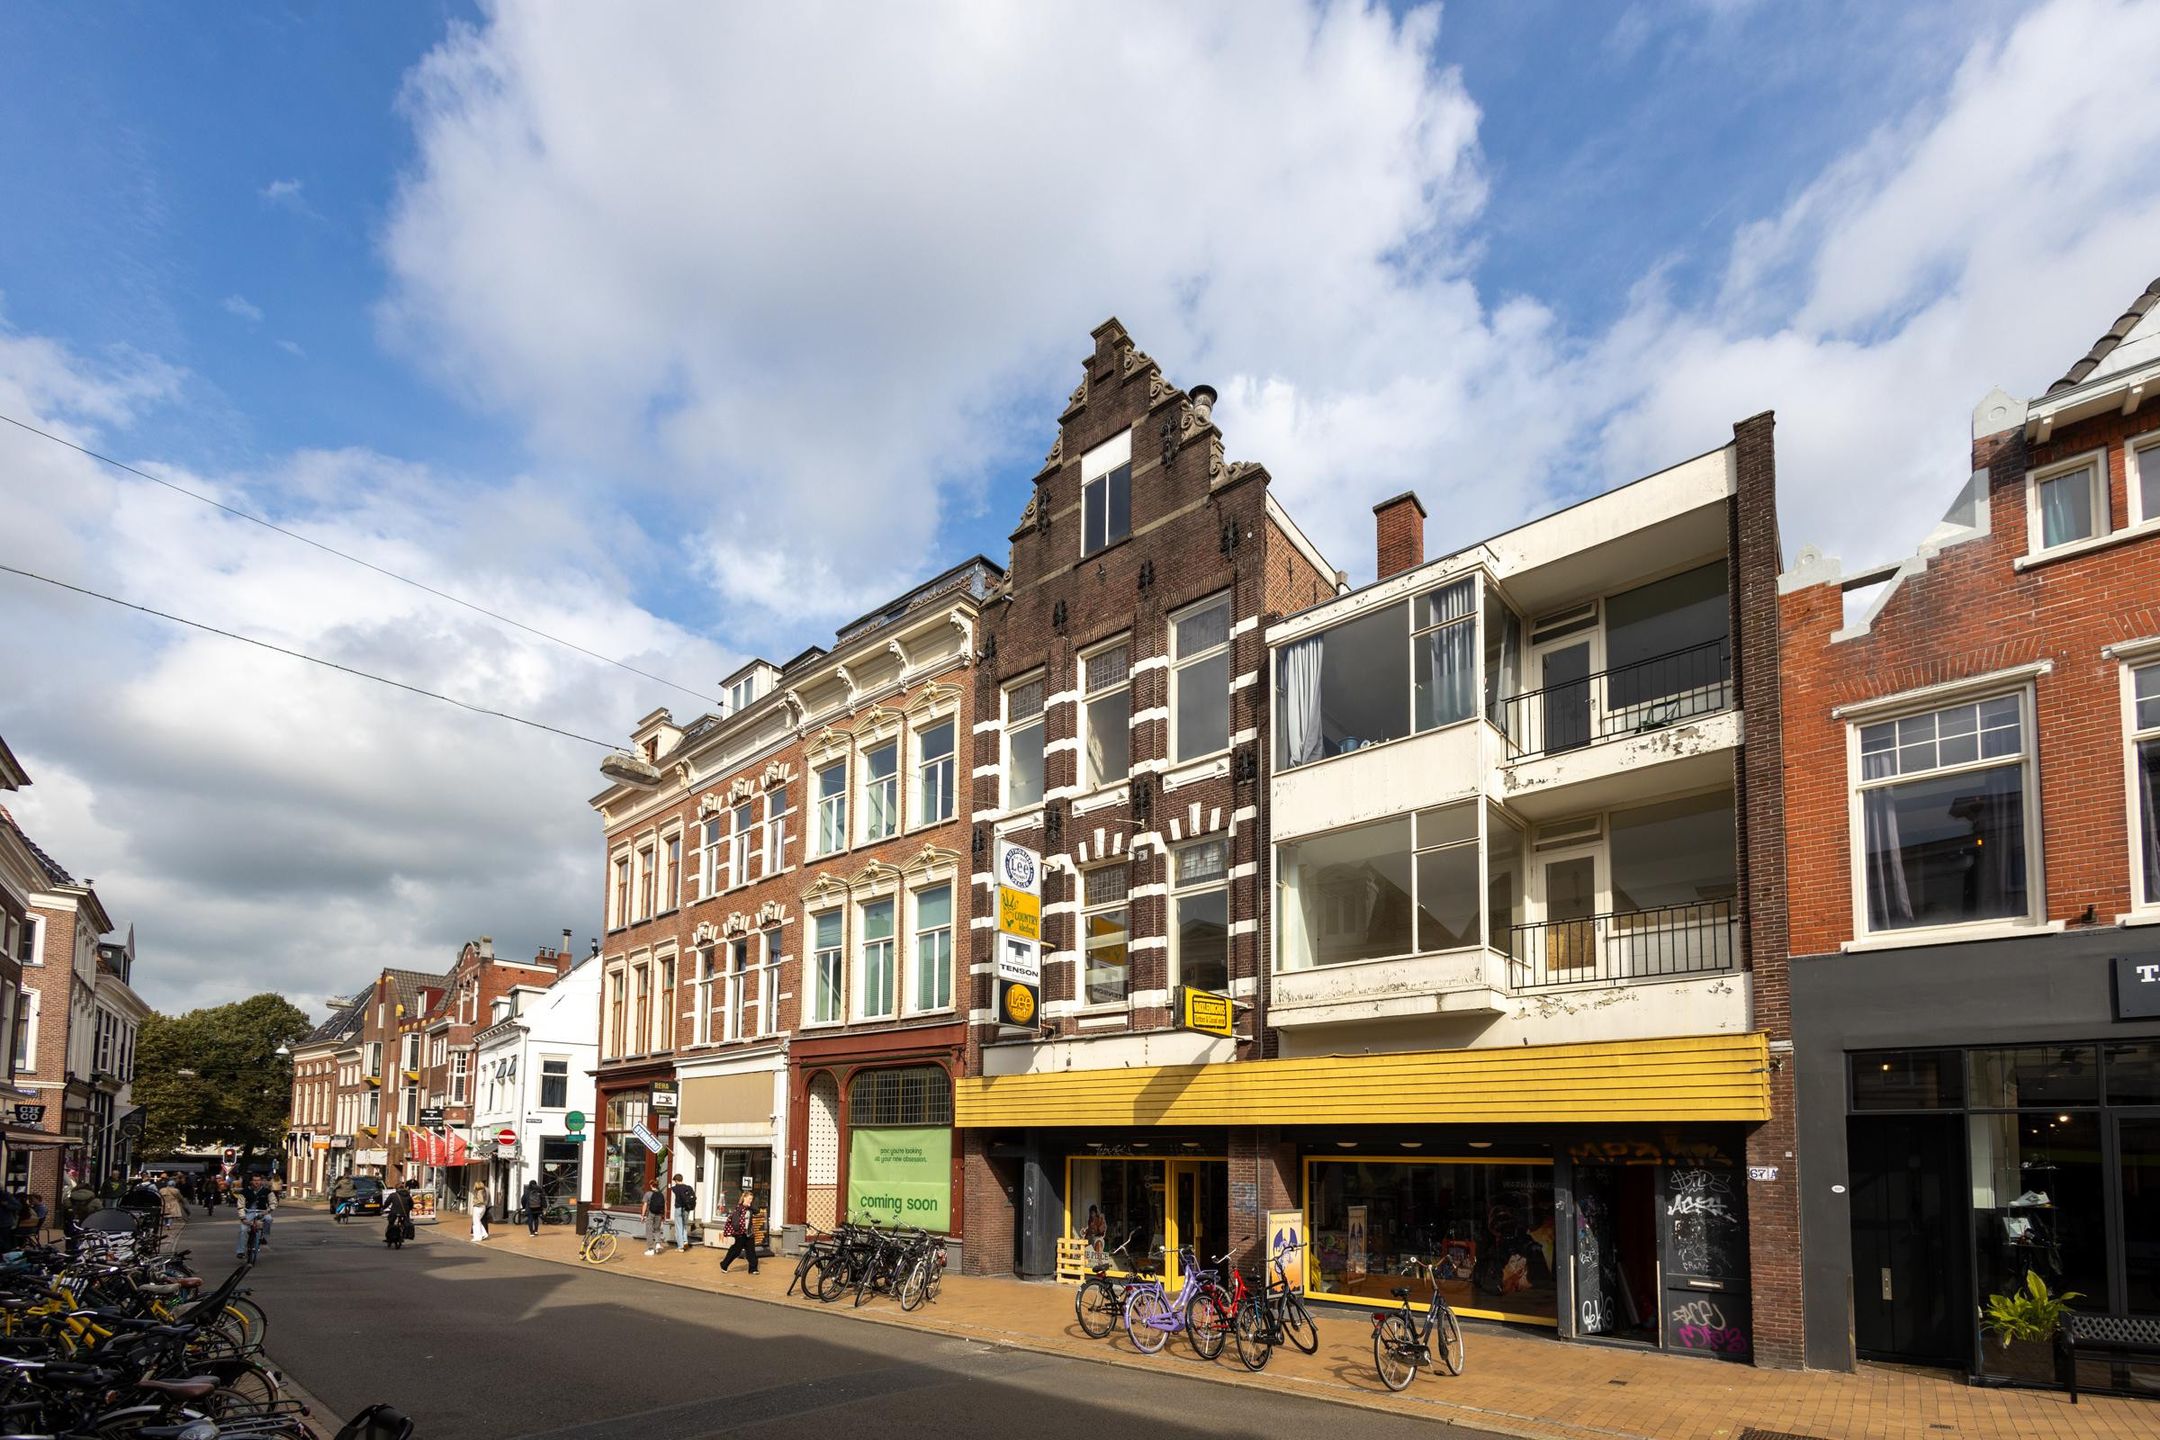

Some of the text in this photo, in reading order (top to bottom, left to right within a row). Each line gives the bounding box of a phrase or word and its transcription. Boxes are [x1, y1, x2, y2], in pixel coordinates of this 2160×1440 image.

[1011, 859, 1029, 875] Lee
[1014, 911, 1038, 926] COUNTRY
[1000, 963, 1039, 977] TENSON
[2136, 964, 2160, 982] T
[1010, 989, 1031, 1008] Lee
[905, 1148, 922, 1156] looking
[860, 1193, 938, 1214] coming soon
